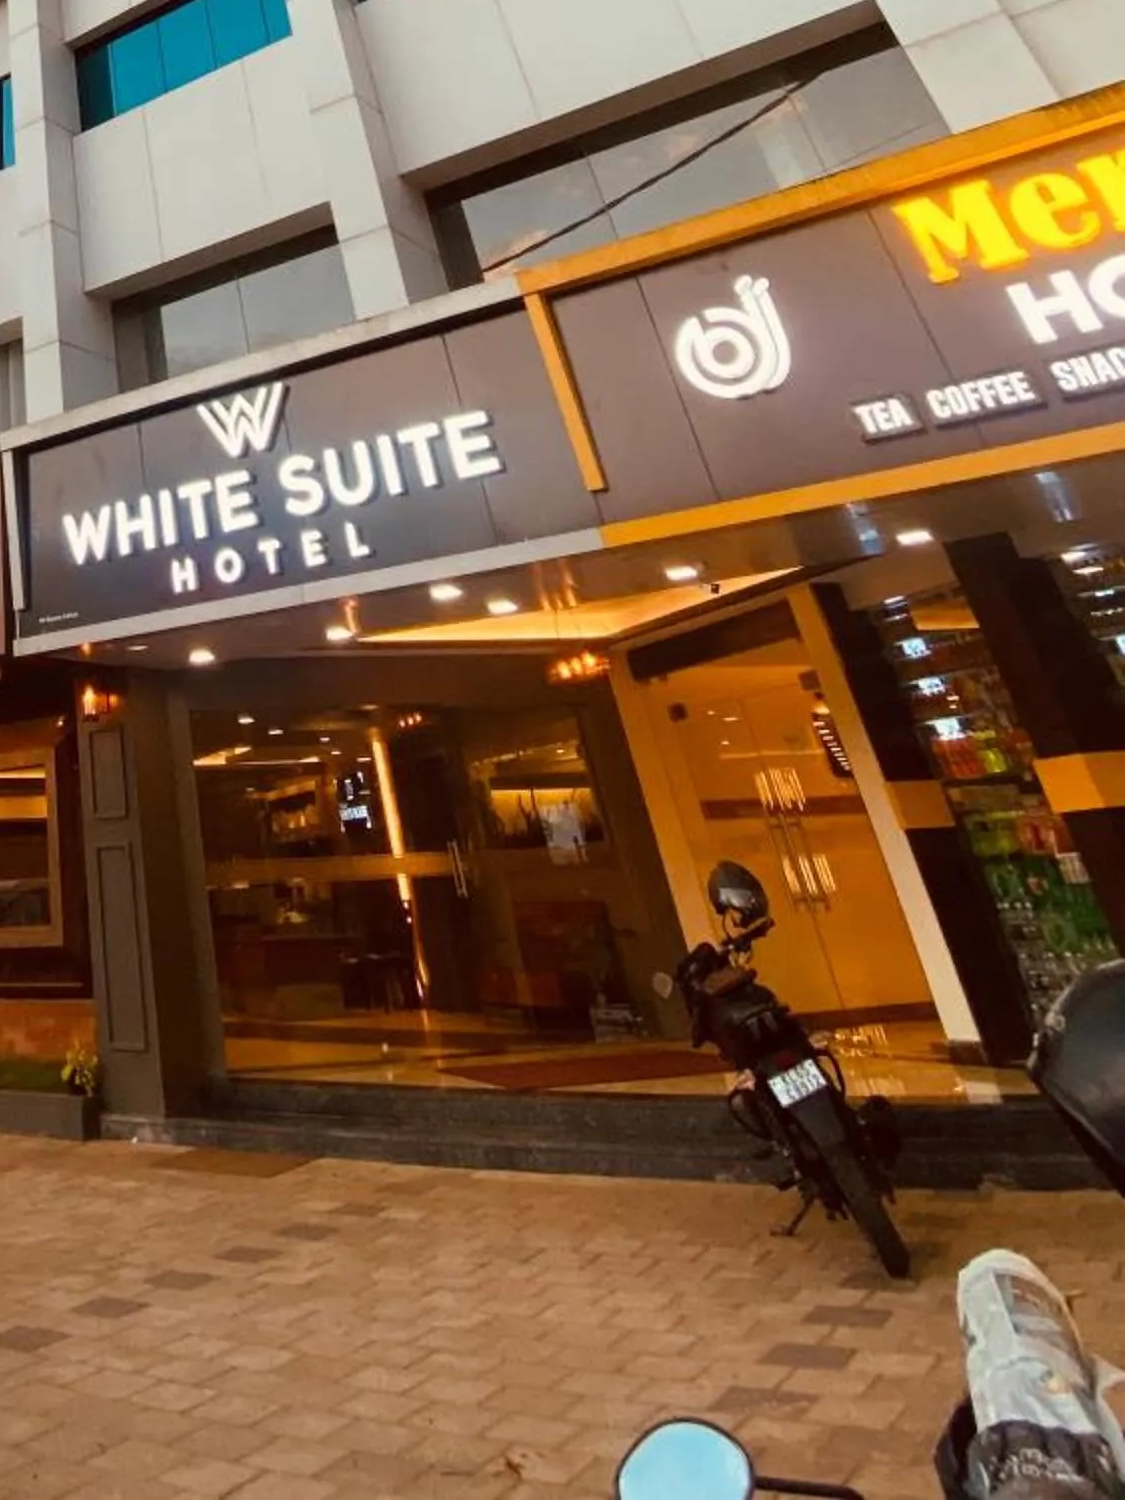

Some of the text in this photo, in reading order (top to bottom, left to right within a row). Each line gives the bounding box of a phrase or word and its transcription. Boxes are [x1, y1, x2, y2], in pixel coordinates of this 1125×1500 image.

[852, 397, 912, 436] TEA
[926, 370, 1036, 420] COFFEE
[62, 409, 504, 566] WHITE SUITE
[170, 521, 372, 595] HOTEL
